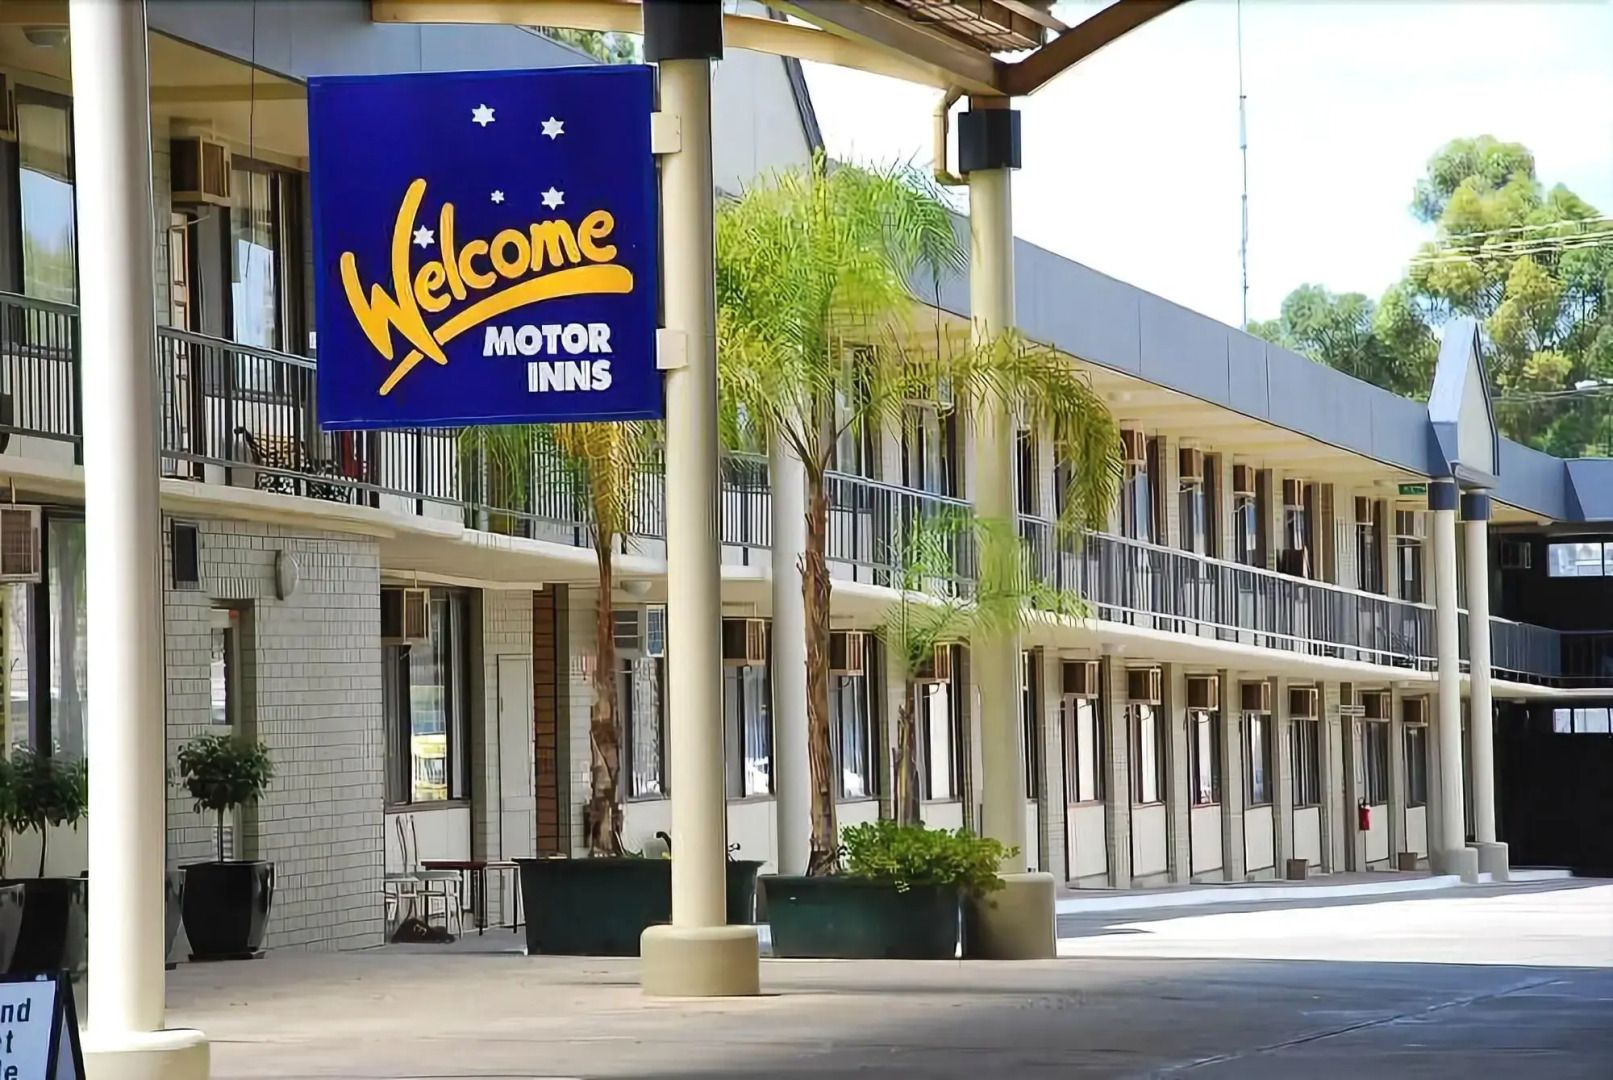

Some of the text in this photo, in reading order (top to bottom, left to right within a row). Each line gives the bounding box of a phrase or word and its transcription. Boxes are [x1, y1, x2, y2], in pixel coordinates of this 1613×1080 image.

[340, 178, 617, 366] Welcome
[482, 322, 613, 357] MOTOR
[527, 359, 613, 393] INNS
